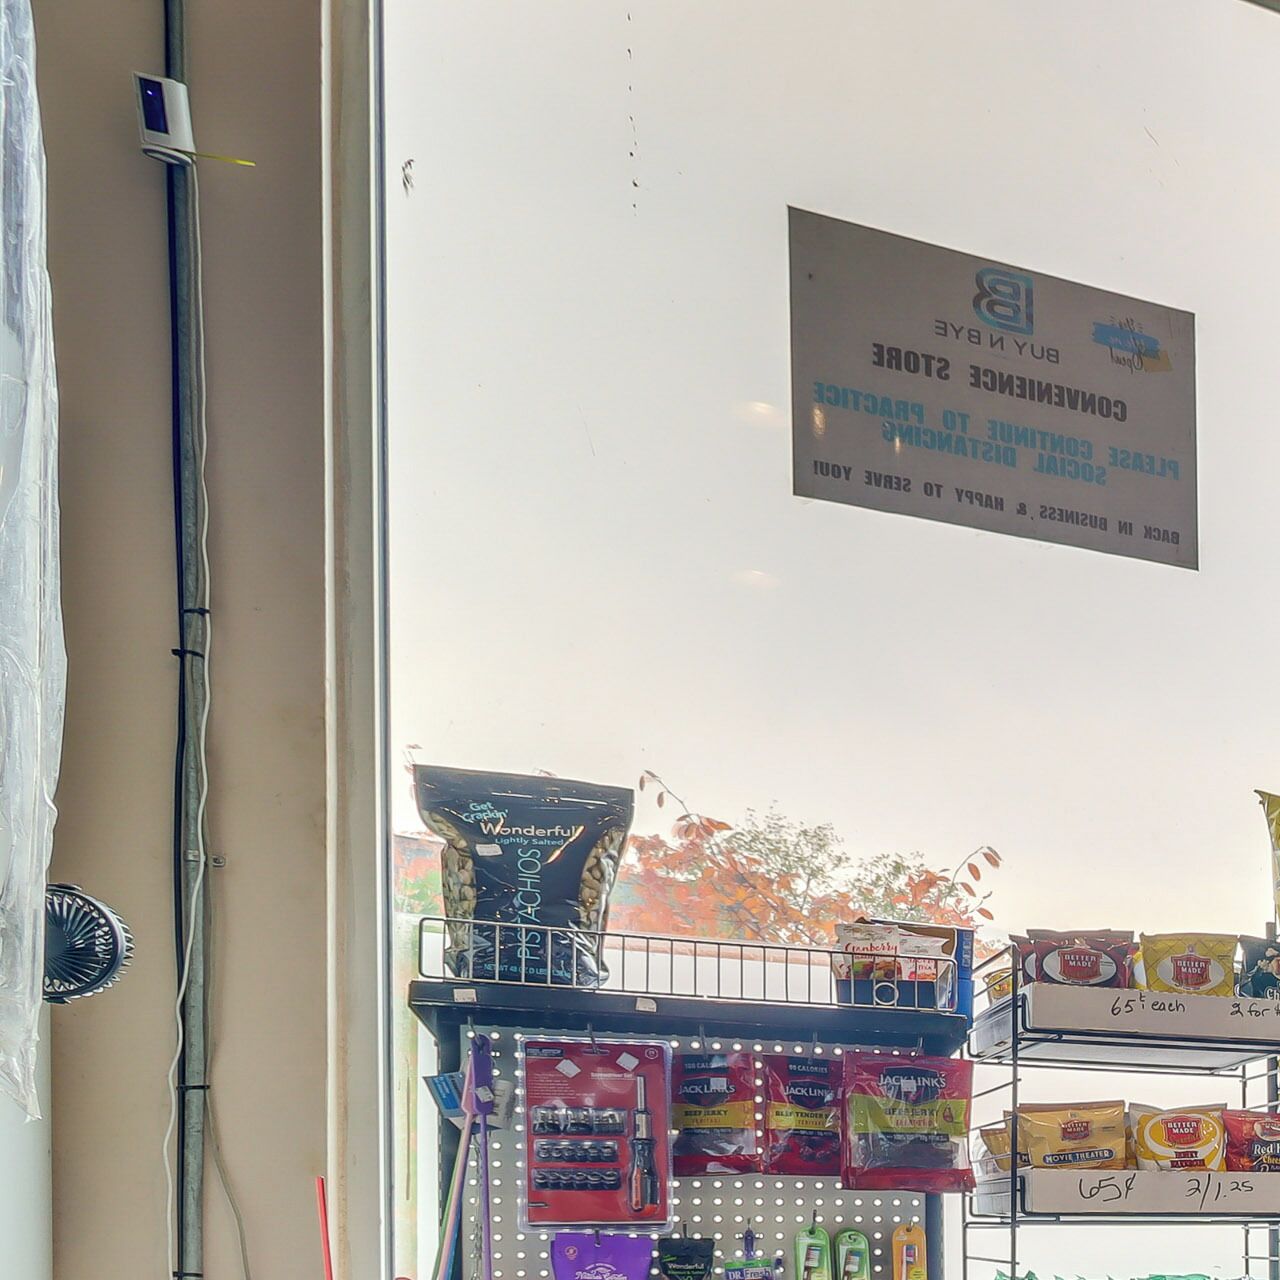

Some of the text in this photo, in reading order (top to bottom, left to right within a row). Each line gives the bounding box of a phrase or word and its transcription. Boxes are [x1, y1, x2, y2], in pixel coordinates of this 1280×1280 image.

[470, 802, 493, 810] Get
[480, 821, 576, 837] Wonderful
[1064, 953, 1097, 962] BETTER
[1152, 1002, 1186, 1013] each
[1247, 1006, 1270, 1018] for
[784, 1085, 808, 1097] JACK
[1168, 1121, 1200, 1130] BETTER
[1254, 1143, 1272, 1155] Red
[1046, 1150, 1112, 1164] MOVIE THEATER
[728, 1269, 771, 1280] DR. Fresh
